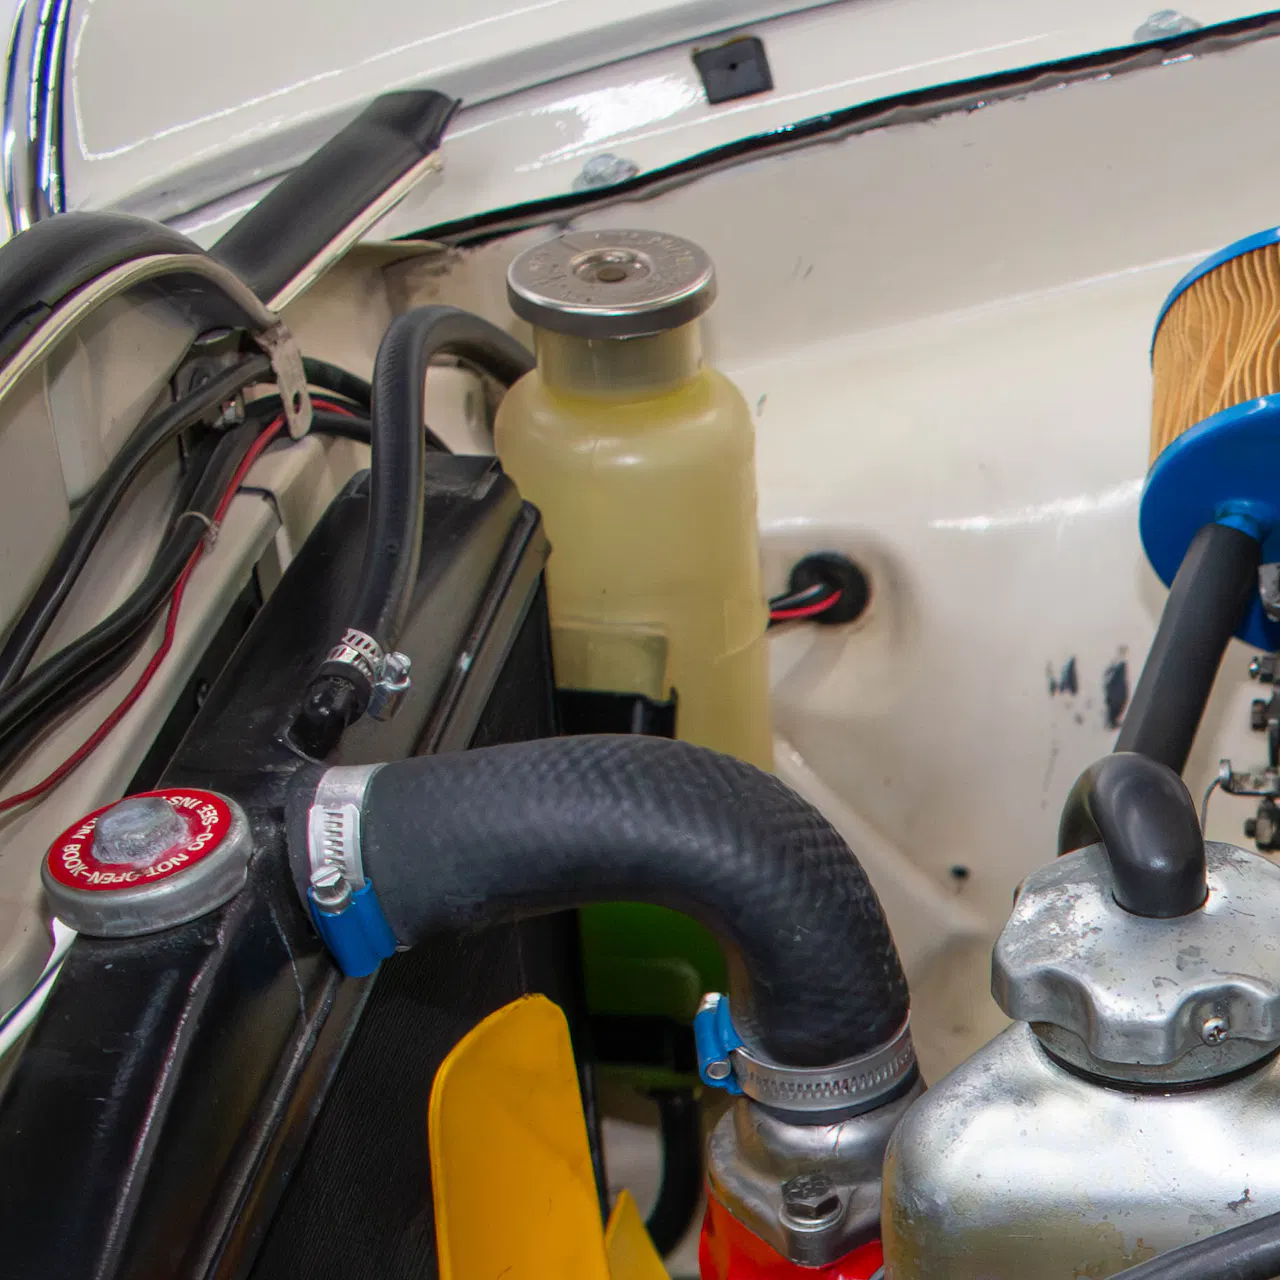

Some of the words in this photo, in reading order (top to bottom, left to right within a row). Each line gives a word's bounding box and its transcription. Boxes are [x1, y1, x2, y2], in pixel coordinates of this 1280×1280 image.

[197, 803, 219, 826] SEE
[61, 844, 89, 876] BOOK
[147, 853, 190, 877] NOT
